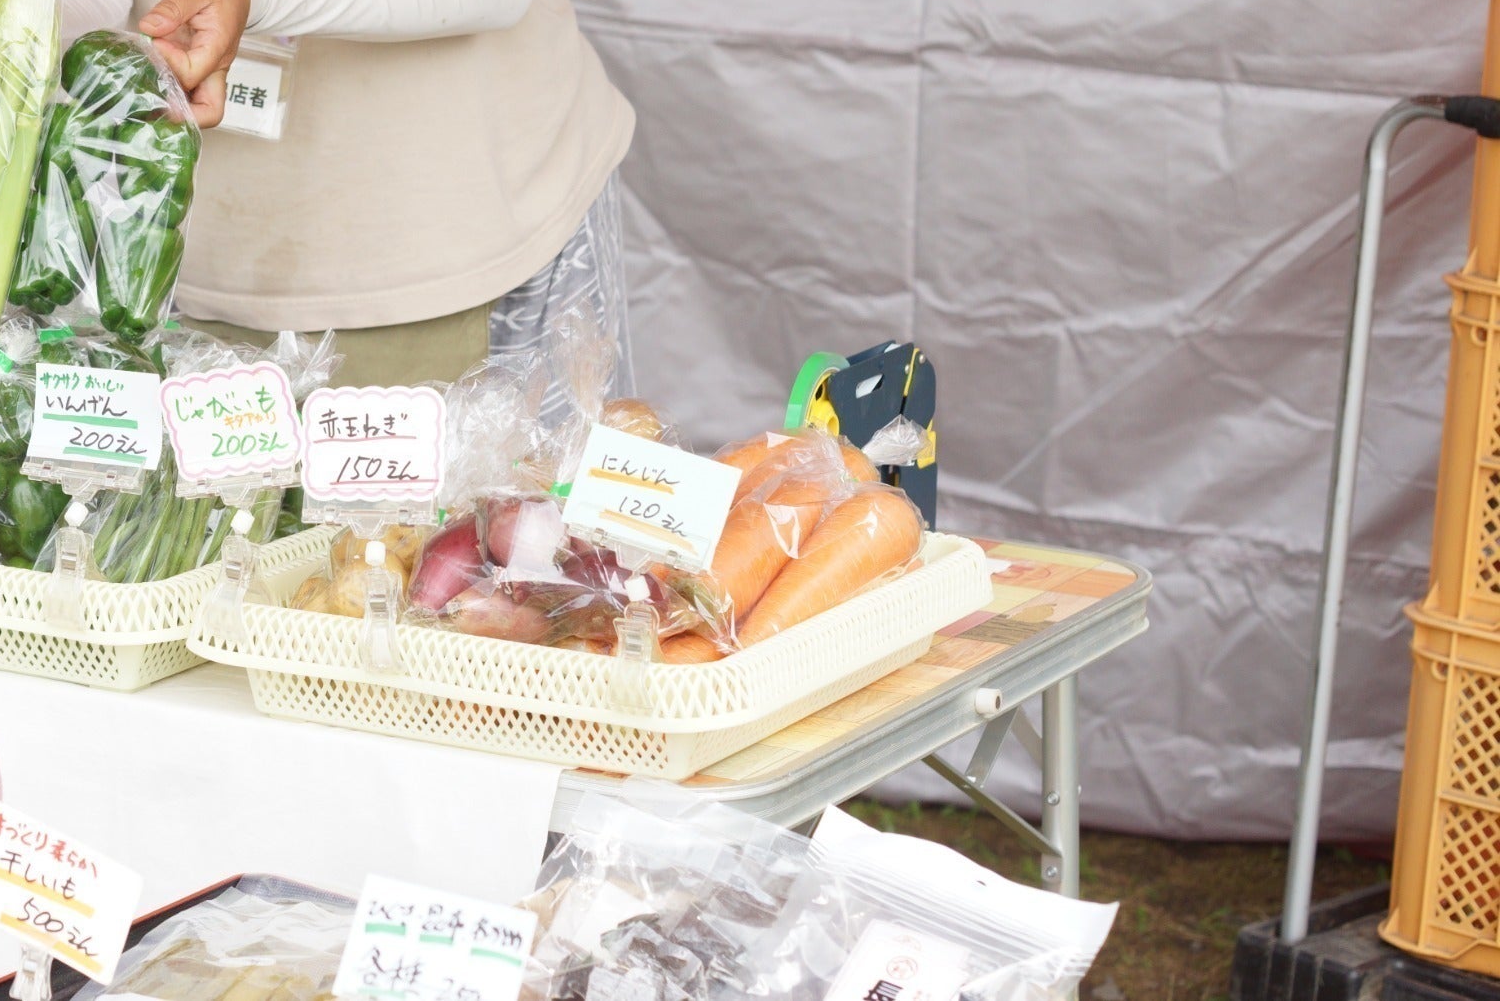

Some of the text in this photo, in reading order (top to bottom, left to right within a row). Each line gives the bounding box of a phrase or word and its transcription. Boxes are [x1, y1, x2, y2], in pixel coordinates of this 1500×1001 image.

[225, 82, 268, 109] 店者
[45, 395, 128, 417] いんげん
[175, 385, 276, 422] じゃがいも
[318, 408, 409, 439] 赤玉ねぎ
[68, 426, 148, 455] 200えん
[211, 431, 290, 458] 200えん
[335, 455, 420, 483] 150えん
[601, 454, 681, 487] にんじん
[0, 849, 76, 900] 干しいも
[16, 896, 99, 957] 500えん
